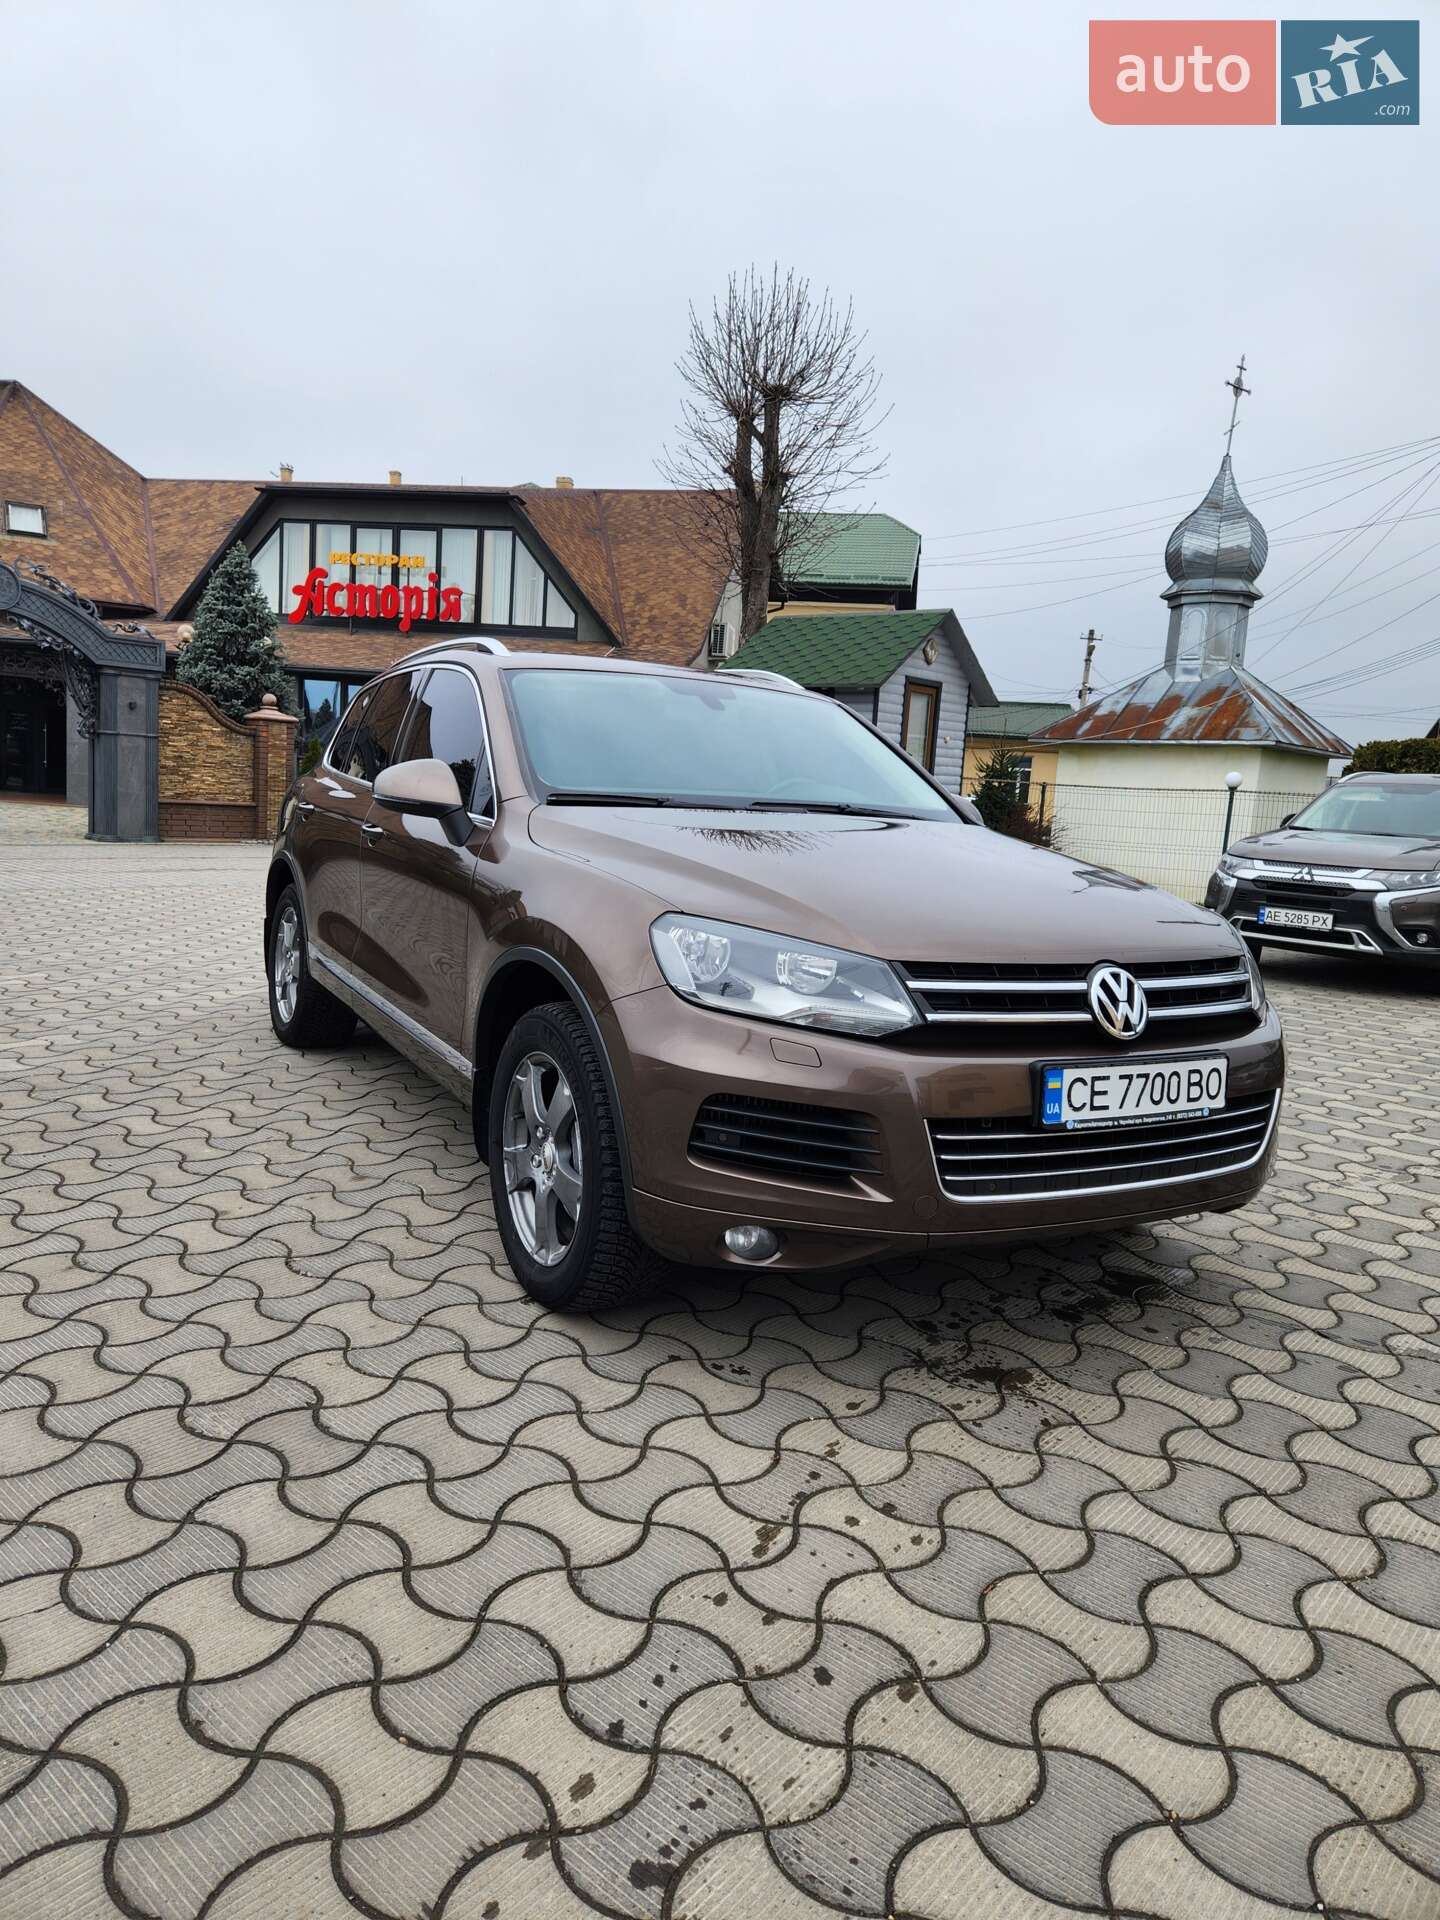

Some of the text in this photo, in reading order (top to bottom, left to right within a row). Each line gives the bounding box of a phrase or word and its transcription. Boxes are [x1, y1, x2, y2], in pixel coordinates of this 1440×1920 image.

[328, 551, 425, 569] РЕСТОРАН
[287, 567, 463, 632] Асторія
[1265, 910, 1329, 927] AE 5285 PX
[1067, 1067, 1222, 1112] CE 7700 BO
[1046, 1104, 1060, 1114] UA
